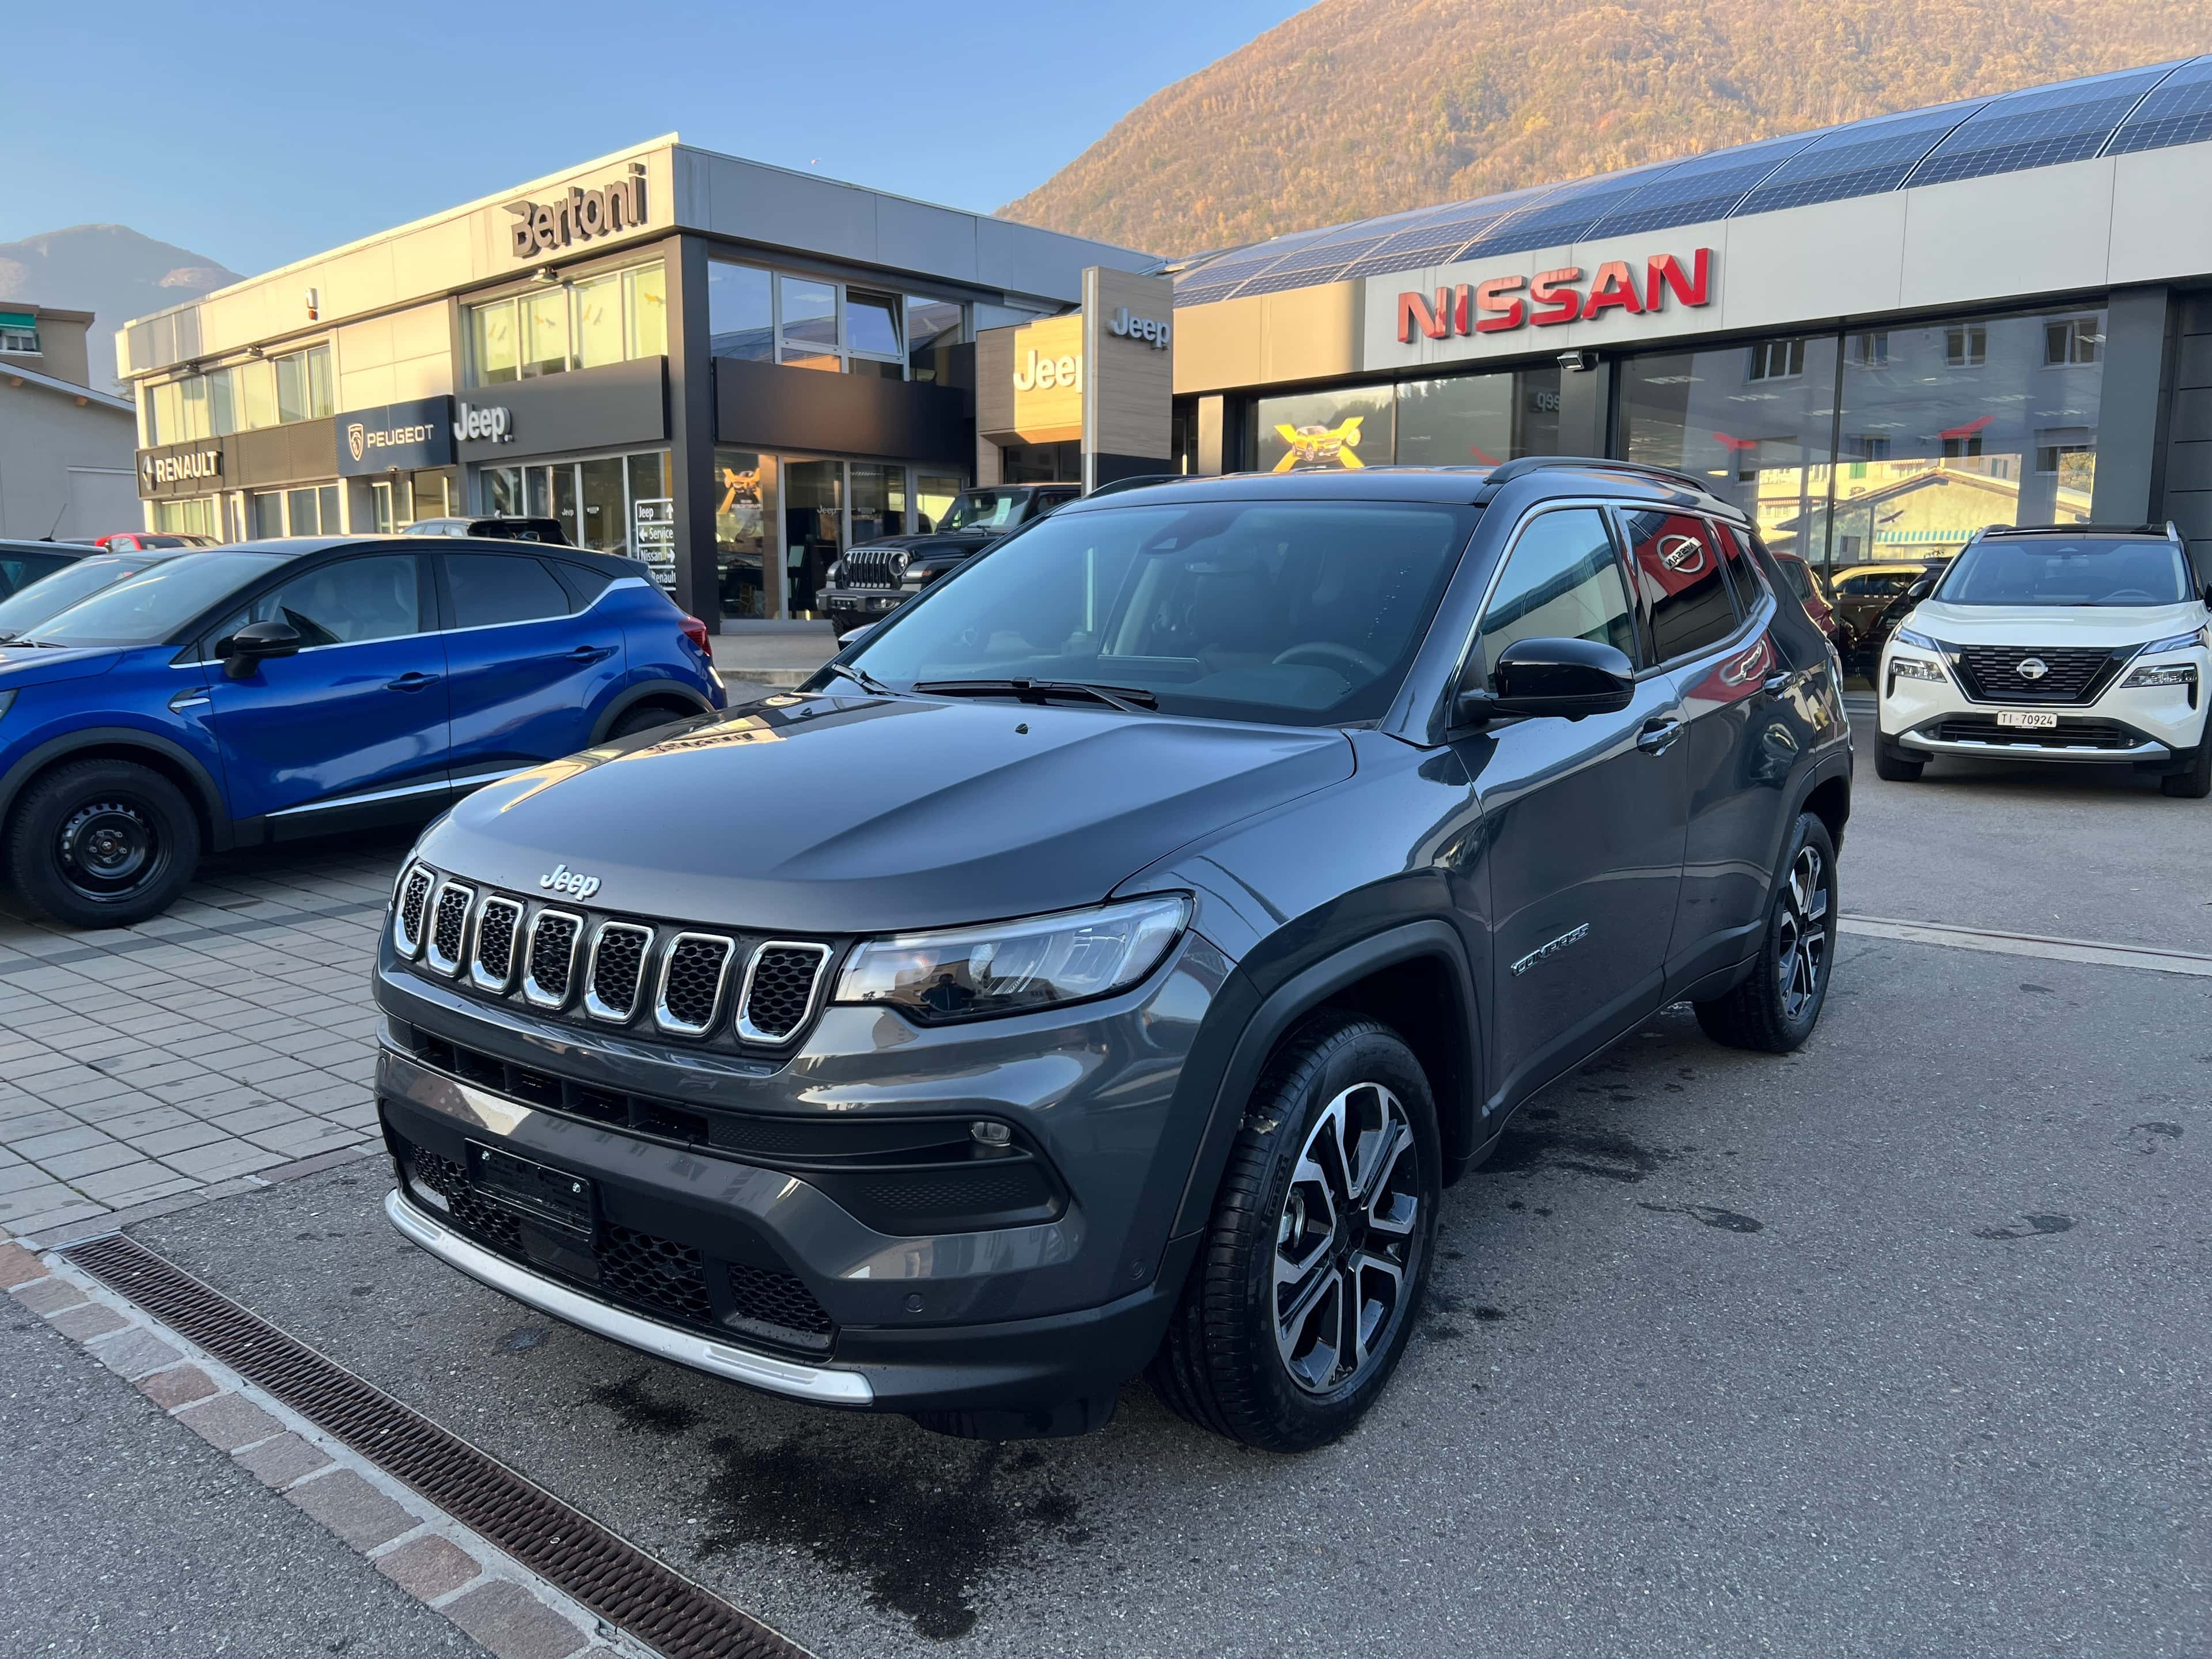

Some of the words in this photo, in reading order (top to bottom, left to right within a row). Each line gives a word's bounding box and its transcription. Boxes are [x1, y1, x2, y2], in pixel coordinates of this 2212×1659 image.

[502, 162, 647, 259] Bertoni
[1397, 248, 1713, 343] NISSAN
[1107, 305, 1171, 349] Jeep
[367, 423, 435, 449] PEUGEOT
[453, 402, 512, 444] Jeep
[155, 450, 218, 483] RENAULT
[638, 506, 654, 521] Jeep
[817, 505, 837, 517] Jeep
[649, 527, 673, 540] Service
[641, 550, 663, 562] Nissan
[2021, 714, 2052, 725] 70924
[539, 863, 602, 902] Jeep
[1510, 922, 1590, 977] COMPASS
